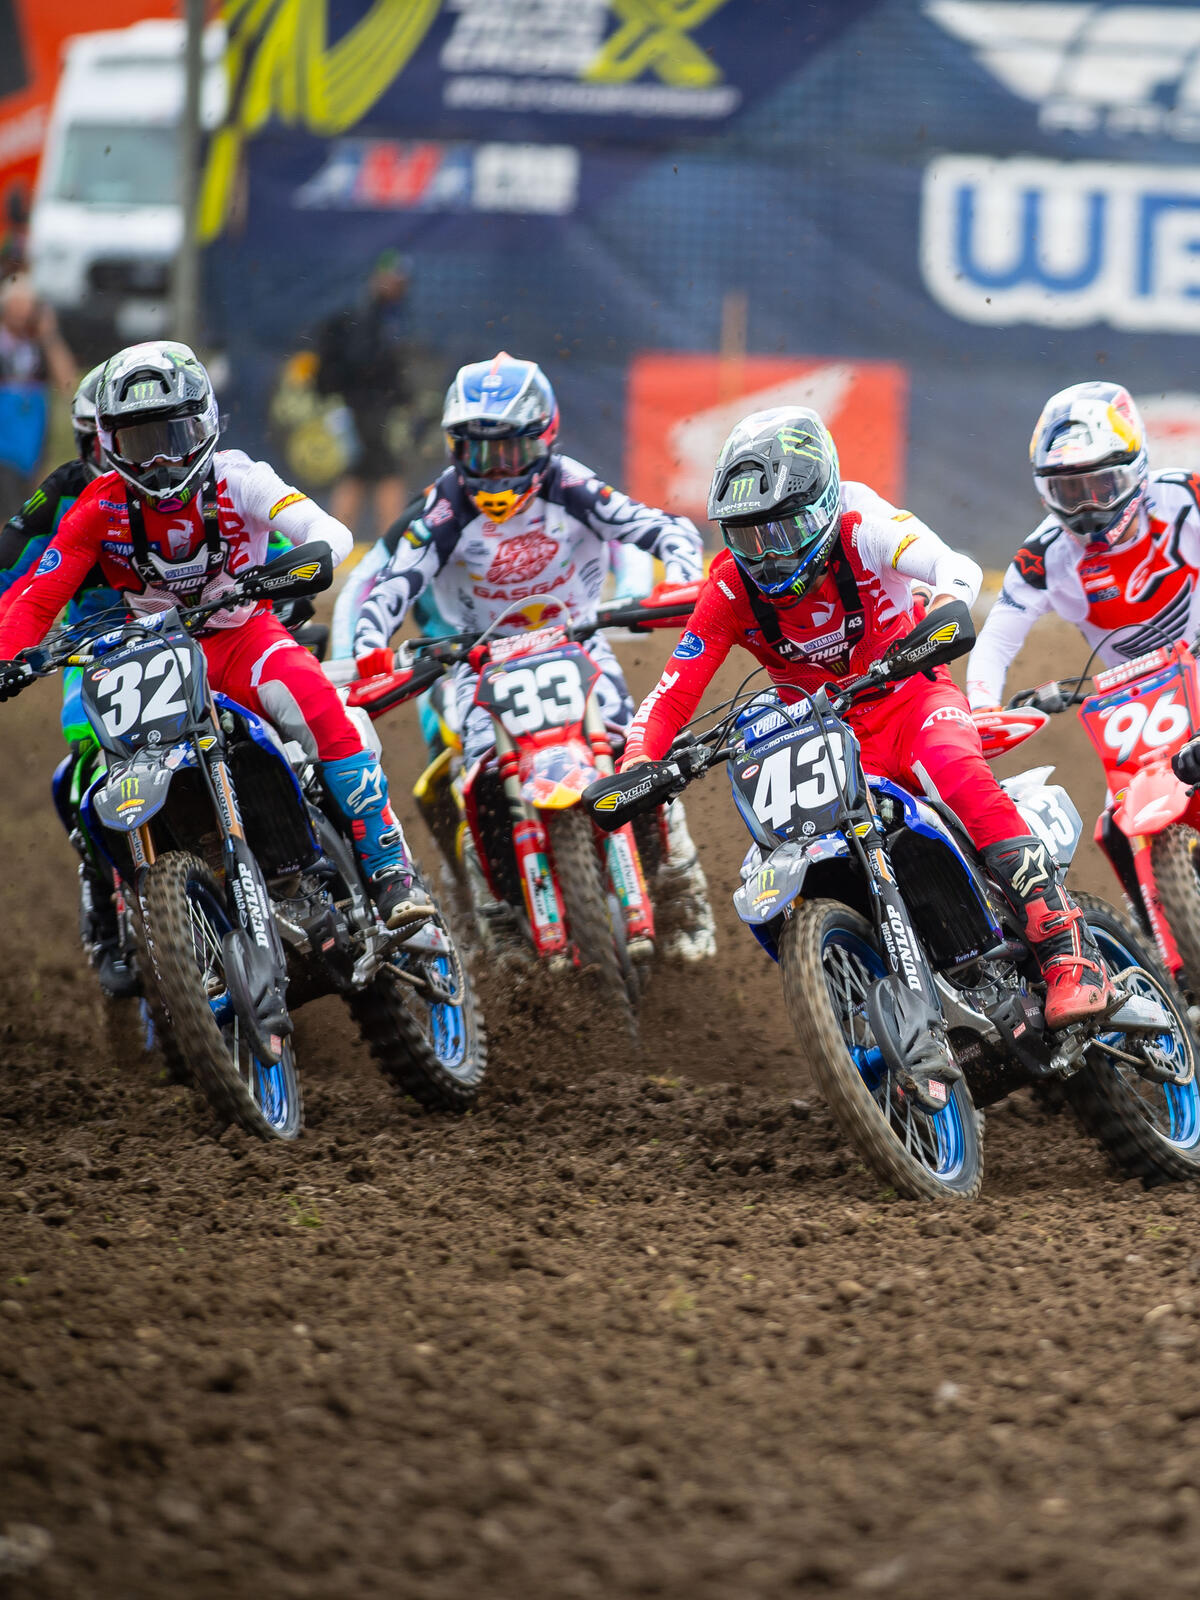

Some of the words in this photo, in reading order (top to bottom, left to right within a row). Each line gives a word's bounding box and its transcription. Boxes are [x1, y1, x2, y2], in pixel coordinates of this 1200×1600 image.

[716, 501, 761, 514] MONSTER
[851, 522, 861, 548] THOR
[210, 553, 224, 564] 32
[167, 577, 208, 591] THOR
[264, 575, 299, 588] CYCRA
[716, 580, 736, 601] THOR
[848, 616, 862, 628] 43
[779, 643, 793, 655] LK
[814, 632, 844, 648] YAMAHA
[905, 639, 940, 661] CYCRA
[808, 642, 849, 663] THOR
[97, 647, 192, 737] 32
[492, 660, 586, 737] 33
[1104, 686, 1190, 768] 96
[753, 725, 815, 757] PROMOTOCROSS
[616, 779, 653, 804] CYCRA
[752, 732, 846, 830] 43
[237, 862, 270, 949] DUNLOP
[886, 904, 923, 992] DUNLOP
